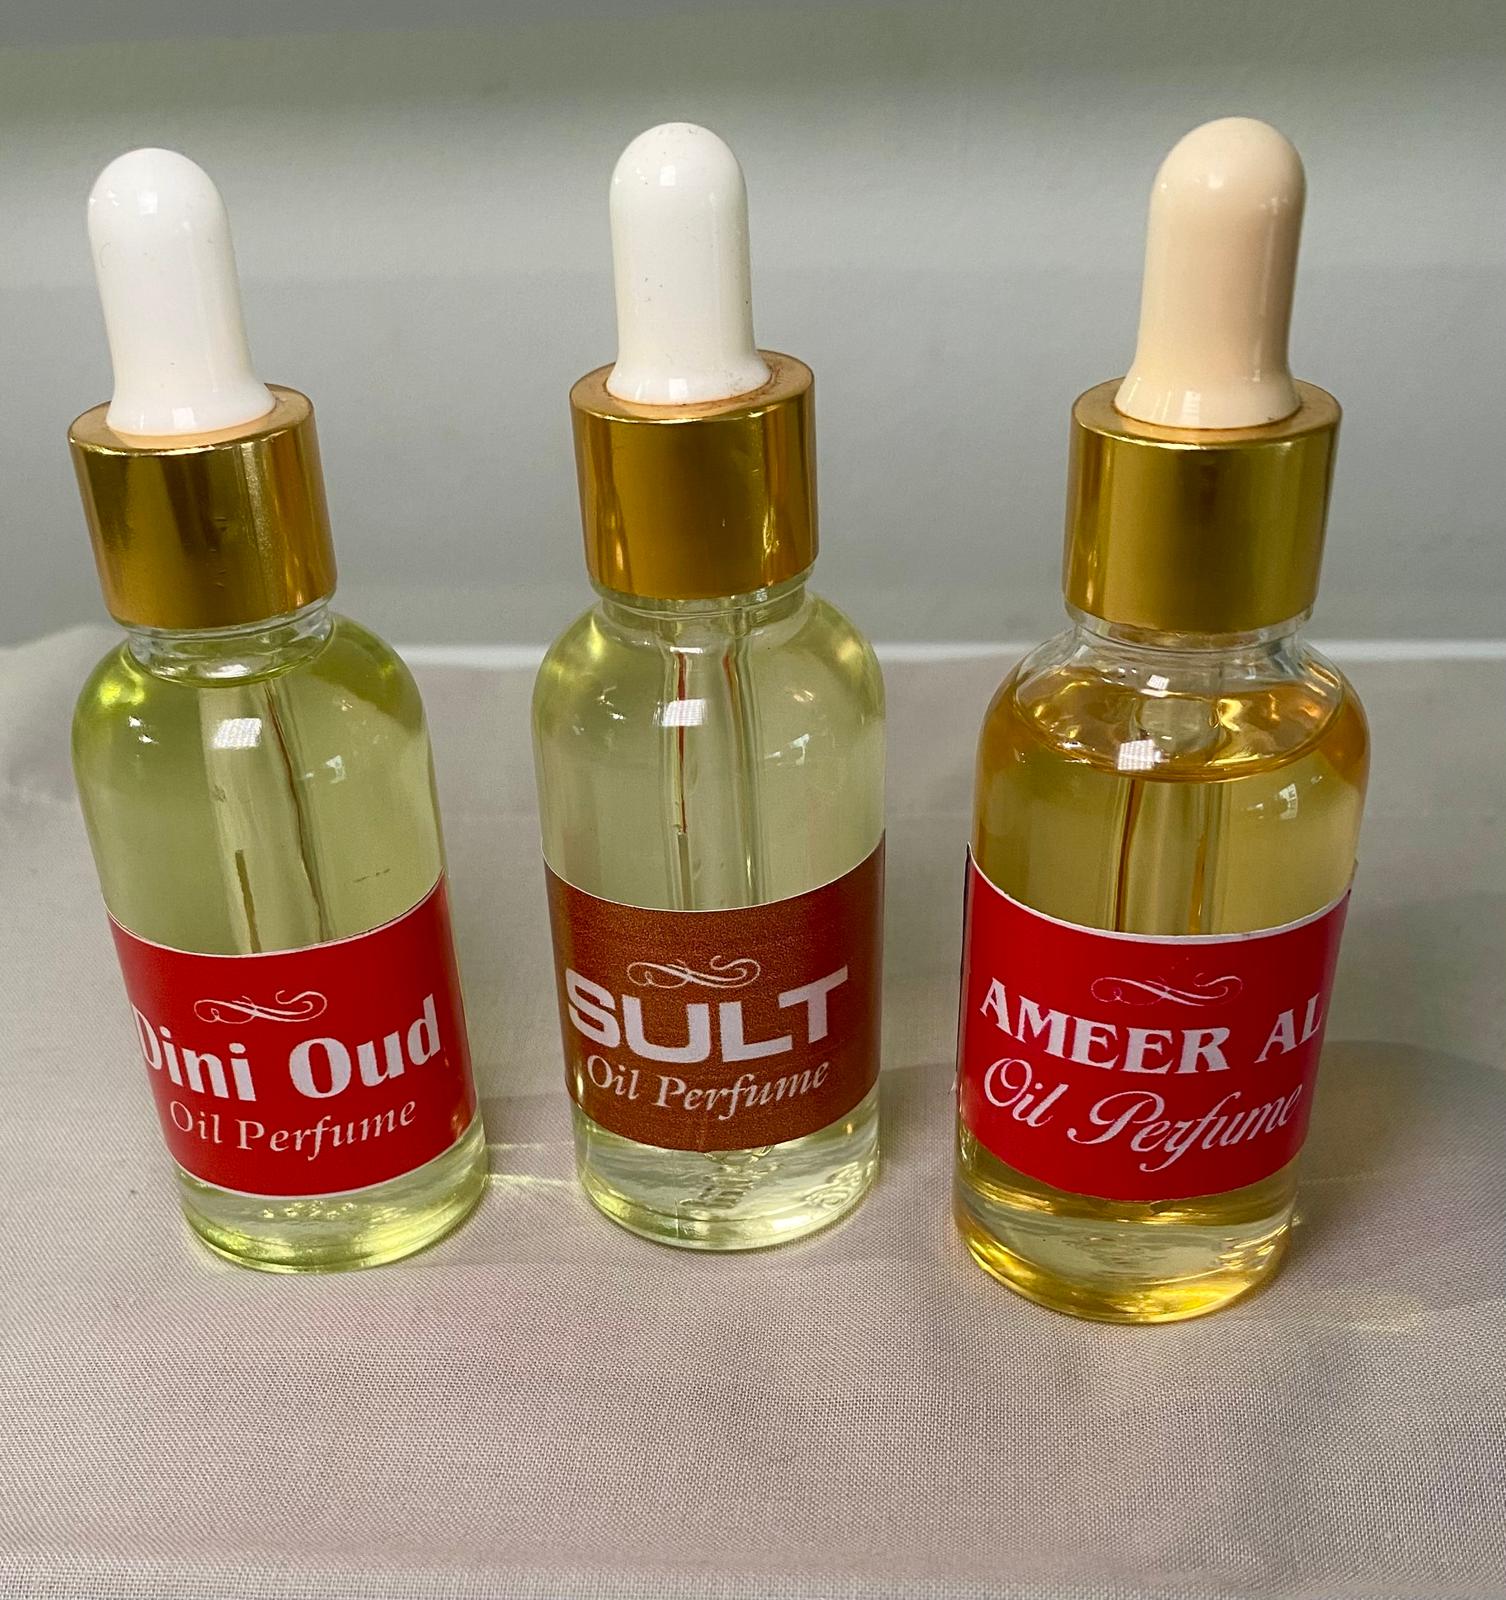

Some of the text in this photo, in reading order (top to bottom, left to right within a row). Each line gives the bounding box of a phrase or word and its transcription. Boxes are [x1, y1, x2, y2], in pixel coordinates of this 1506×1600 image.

[131, 994, 441, 1101] Dini Oud
[565, 964, 848, 1063] SULT
[979, 977, 1230, 1075] AMEER
[170, 1100, 416, 1161] Oil Perfume
[587, 1055, 830, 1121] Oil Perfume
[983, 1058, 1303, 1173] Oil Perfume
